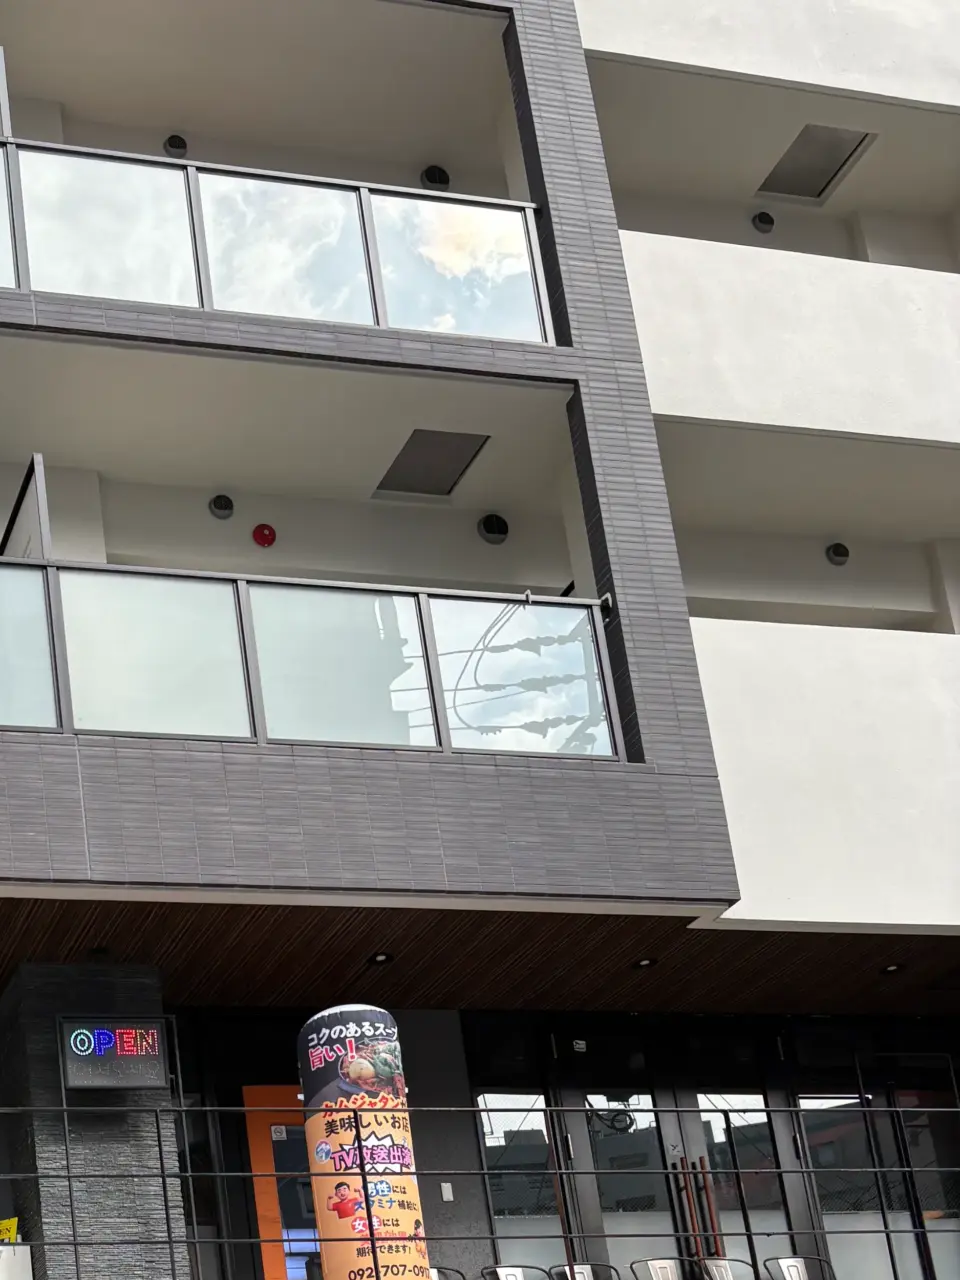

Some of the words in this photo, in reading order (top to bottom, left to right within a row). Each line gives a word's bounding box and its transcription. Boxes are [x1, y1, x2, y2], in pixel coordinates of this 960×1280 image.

[70, 1029, 159, 1055] OPEN
[309, 1038, 356, 1071] 旨い!
[324, 1113, 410, 1138] 美味しいお店
[352, 1216, 400, 1233] 女性には
